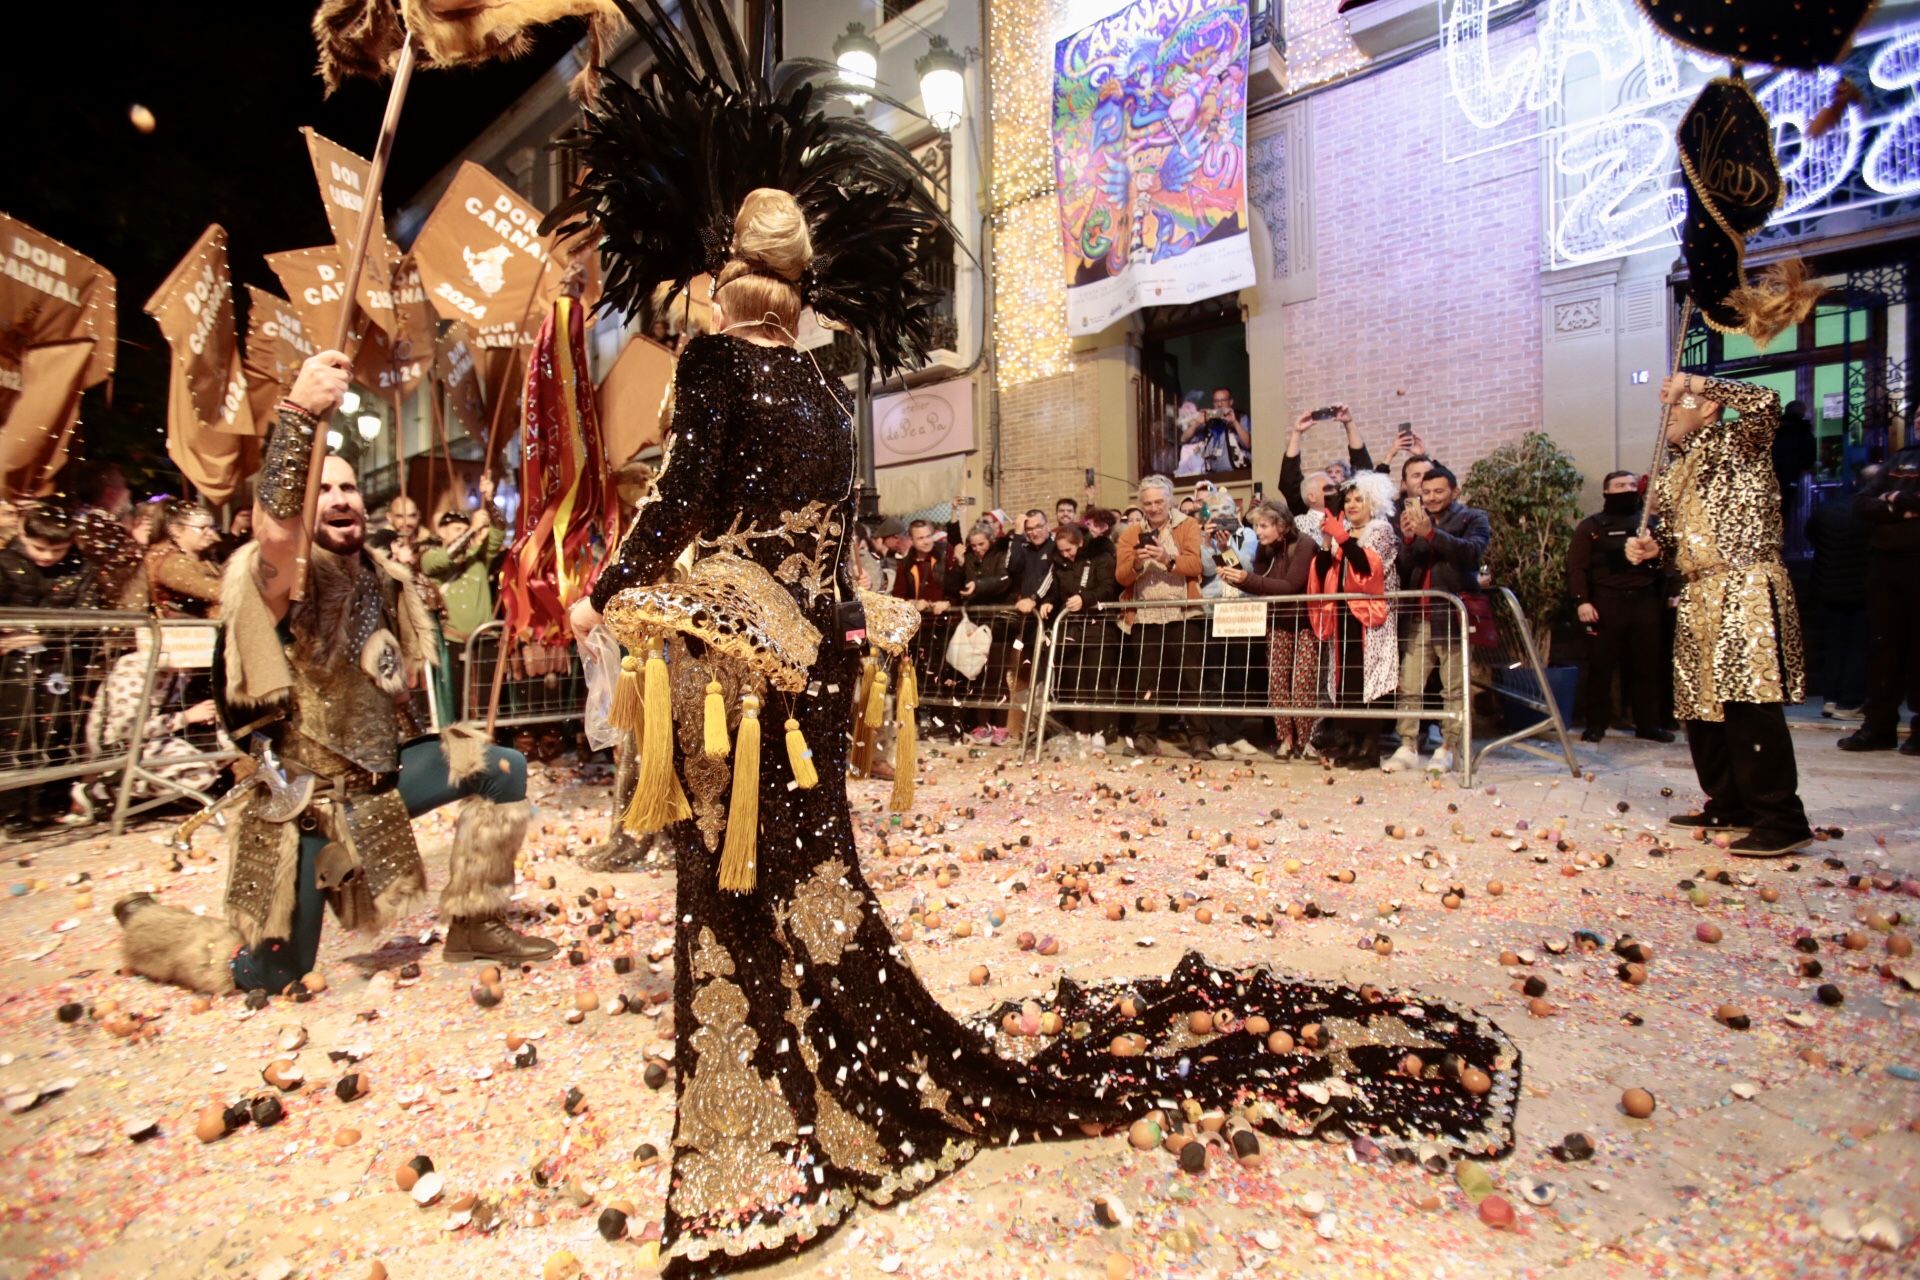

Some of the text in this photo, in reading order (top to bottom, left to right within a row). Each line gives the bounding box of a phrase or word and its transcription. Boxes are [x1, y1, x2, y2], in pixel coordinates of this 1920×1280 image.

[330, 160, 361, 191] DON
[465, 196, 552, 273] CARNAL
[493, 194, 540, 238] DON
[13, 237, 66, 276] DON
[184, 264, 215, 316] DON
[433, 282, 488, 320] 2024
